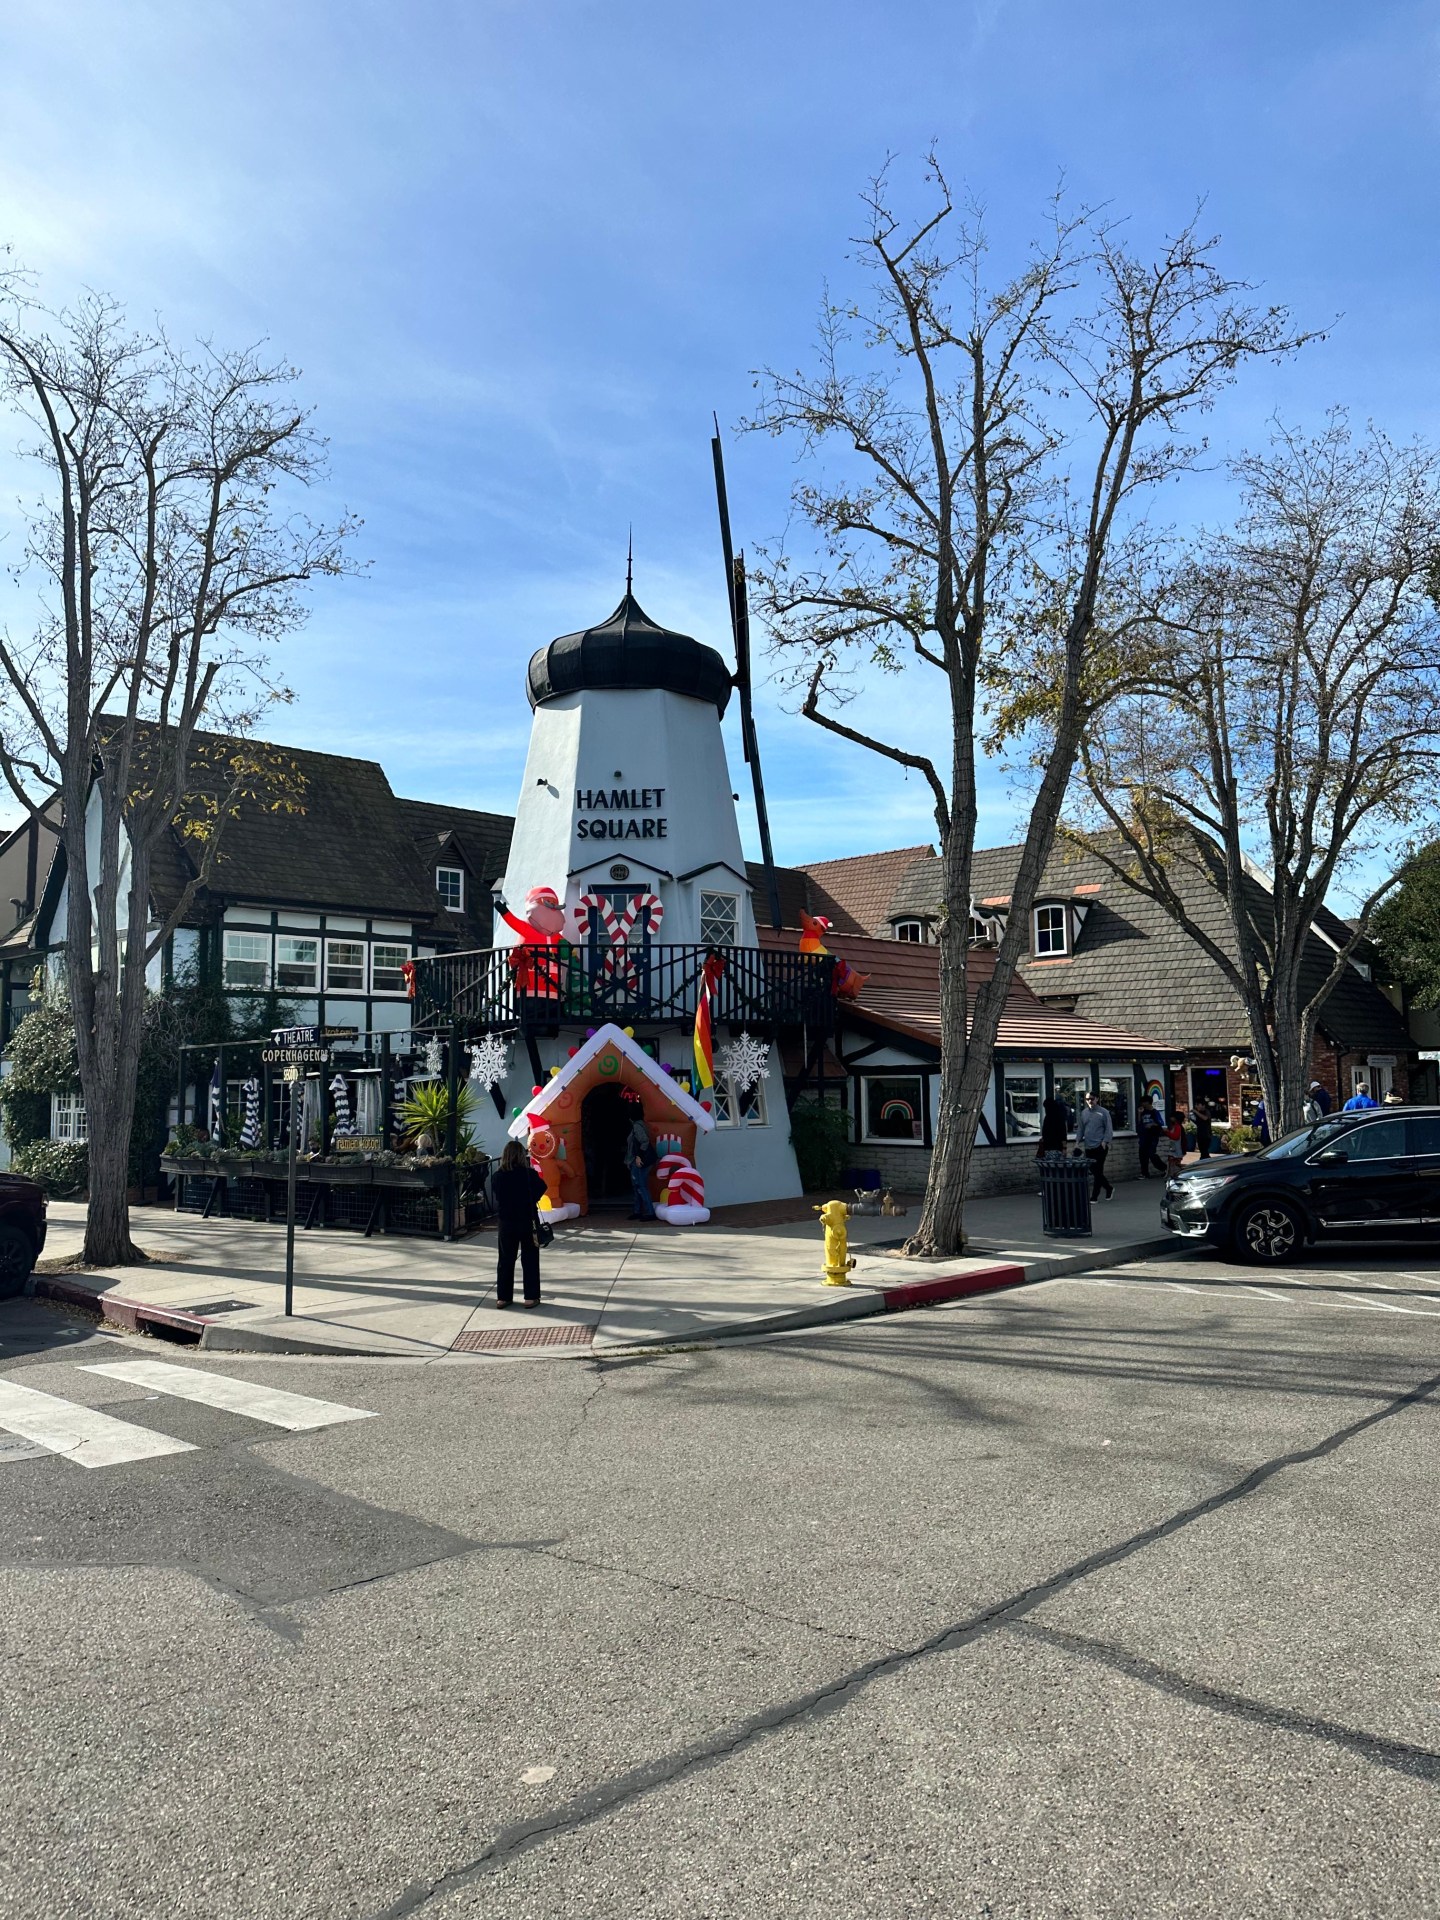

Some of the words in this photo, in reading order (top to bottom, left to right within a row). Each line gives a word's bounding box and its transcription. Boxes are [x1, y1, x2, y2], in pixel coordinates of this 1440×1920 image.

[577, 788, 665, 809] HAMLET
[577, 818, 667, 839] SQUARE
[283, 1029, 314, 1045] THEATRE
[262, 1049, 320, 1062] COPENHAGEN
